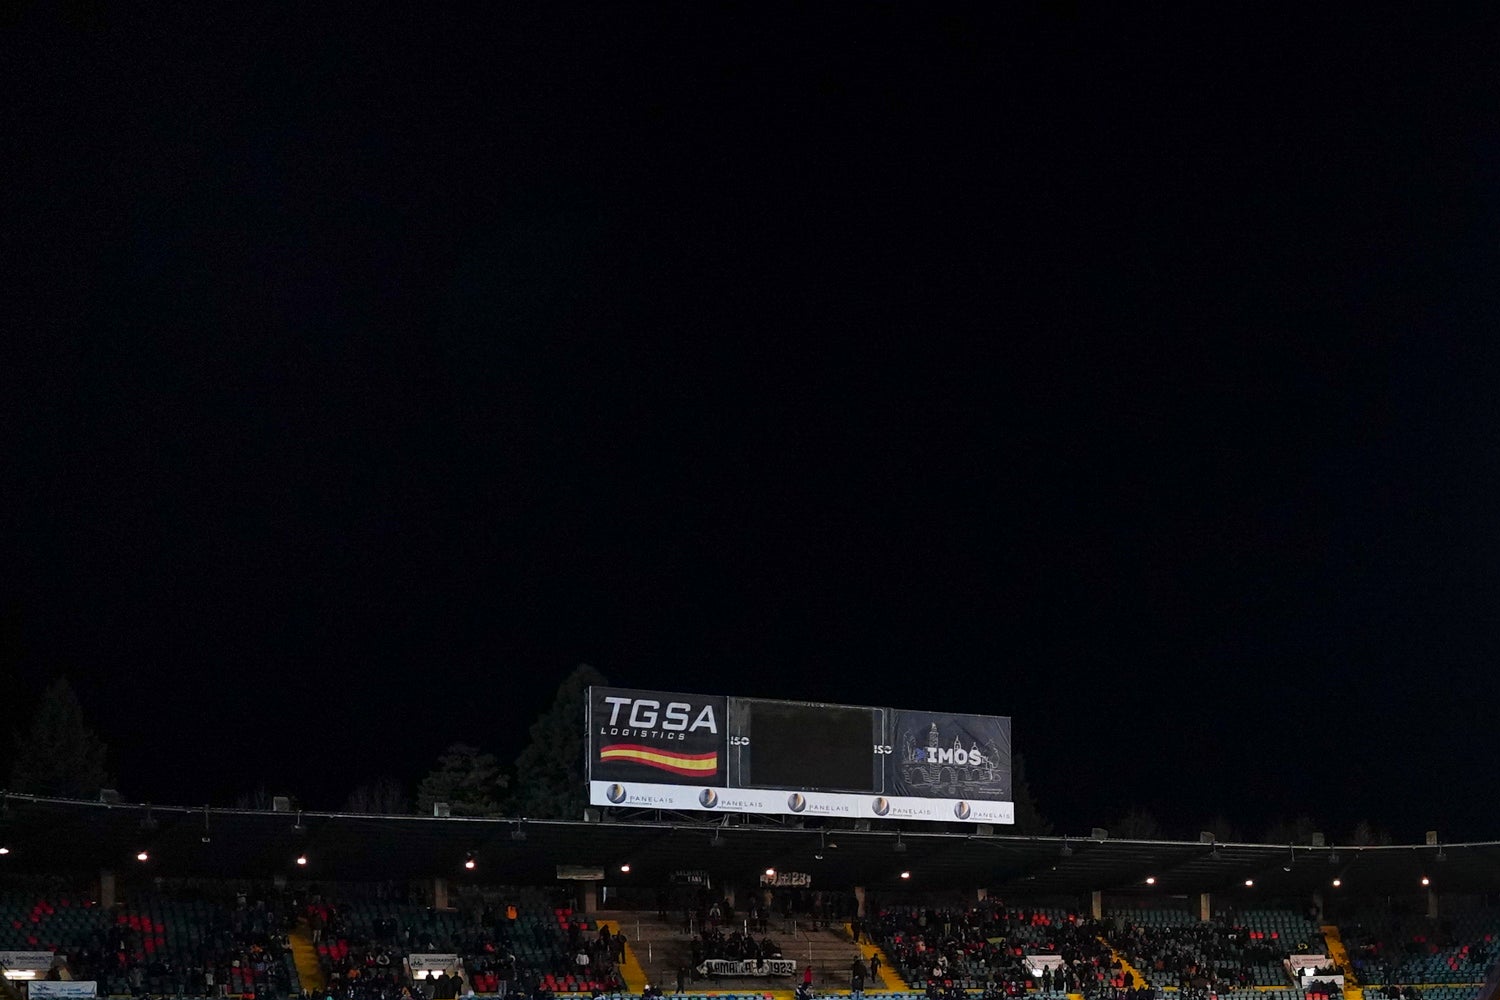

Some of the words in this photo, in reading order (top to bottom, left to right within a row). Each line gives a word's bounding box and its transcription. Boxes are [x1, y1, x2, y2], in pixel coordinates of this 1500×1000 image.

[605, 697, 718, 734] TGSA
[600, 727, 685, 740] LOGISTICS
[873, 744, 893, 755] ISO
[927, 747, 982, 766] IMOS
[629, 795, 674, 804] PANELAIS
[721, 800, 763, 808] PANELAIS
[809, 804, 849, 812] PANELAIS
[770, 961, 793, 974] 1923
